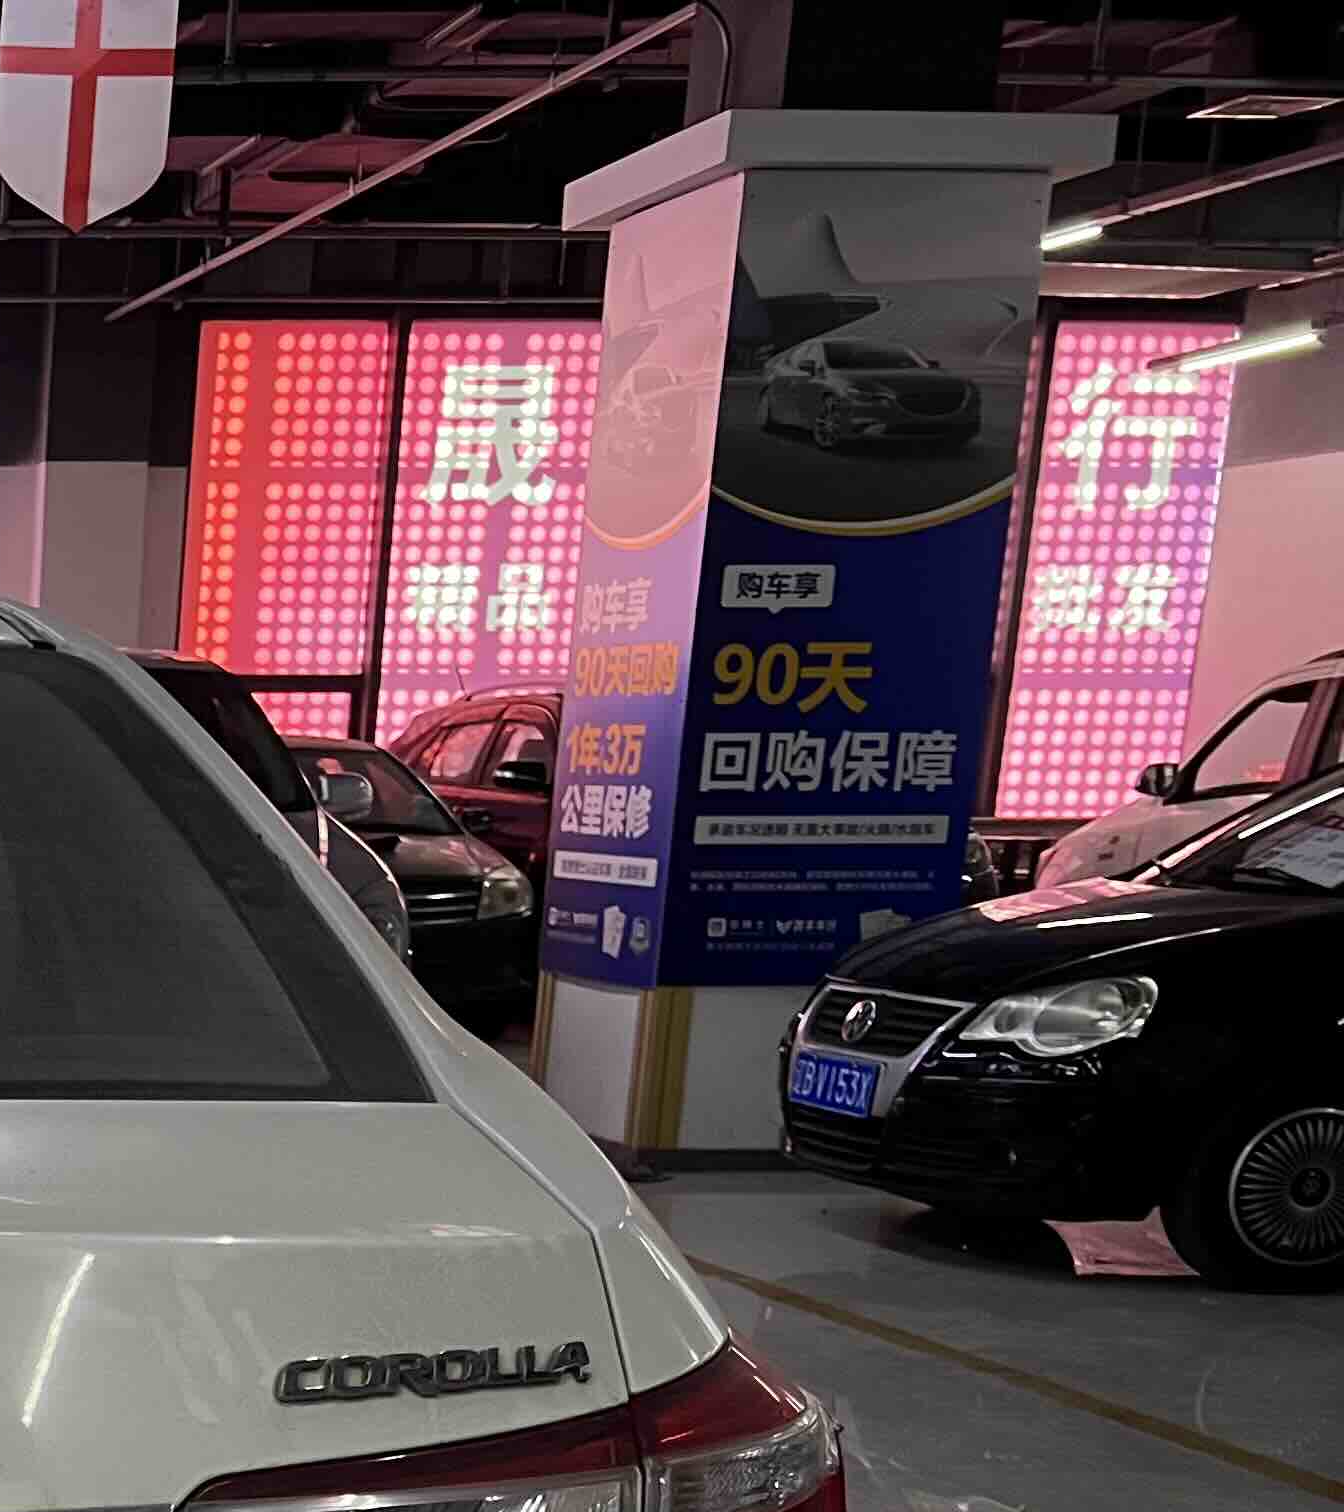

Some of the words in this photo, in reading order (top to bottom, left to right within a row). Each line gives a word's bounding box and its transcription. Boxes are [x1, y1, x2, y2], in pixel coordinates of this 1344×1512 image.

[1060, 361, 1200, 511] 行
[736, 571, 822, 600] 购车享
[575, 641, 679, 697] 90天回购
[713, 641, 873, 714] 90天
[566, 722, 646, 776] 1年3万
[699, 729, 958, 793] 回购保障
[560, 784, 653, 839] 公里保修
[273, 1340, 592, 1404] COROLLA
